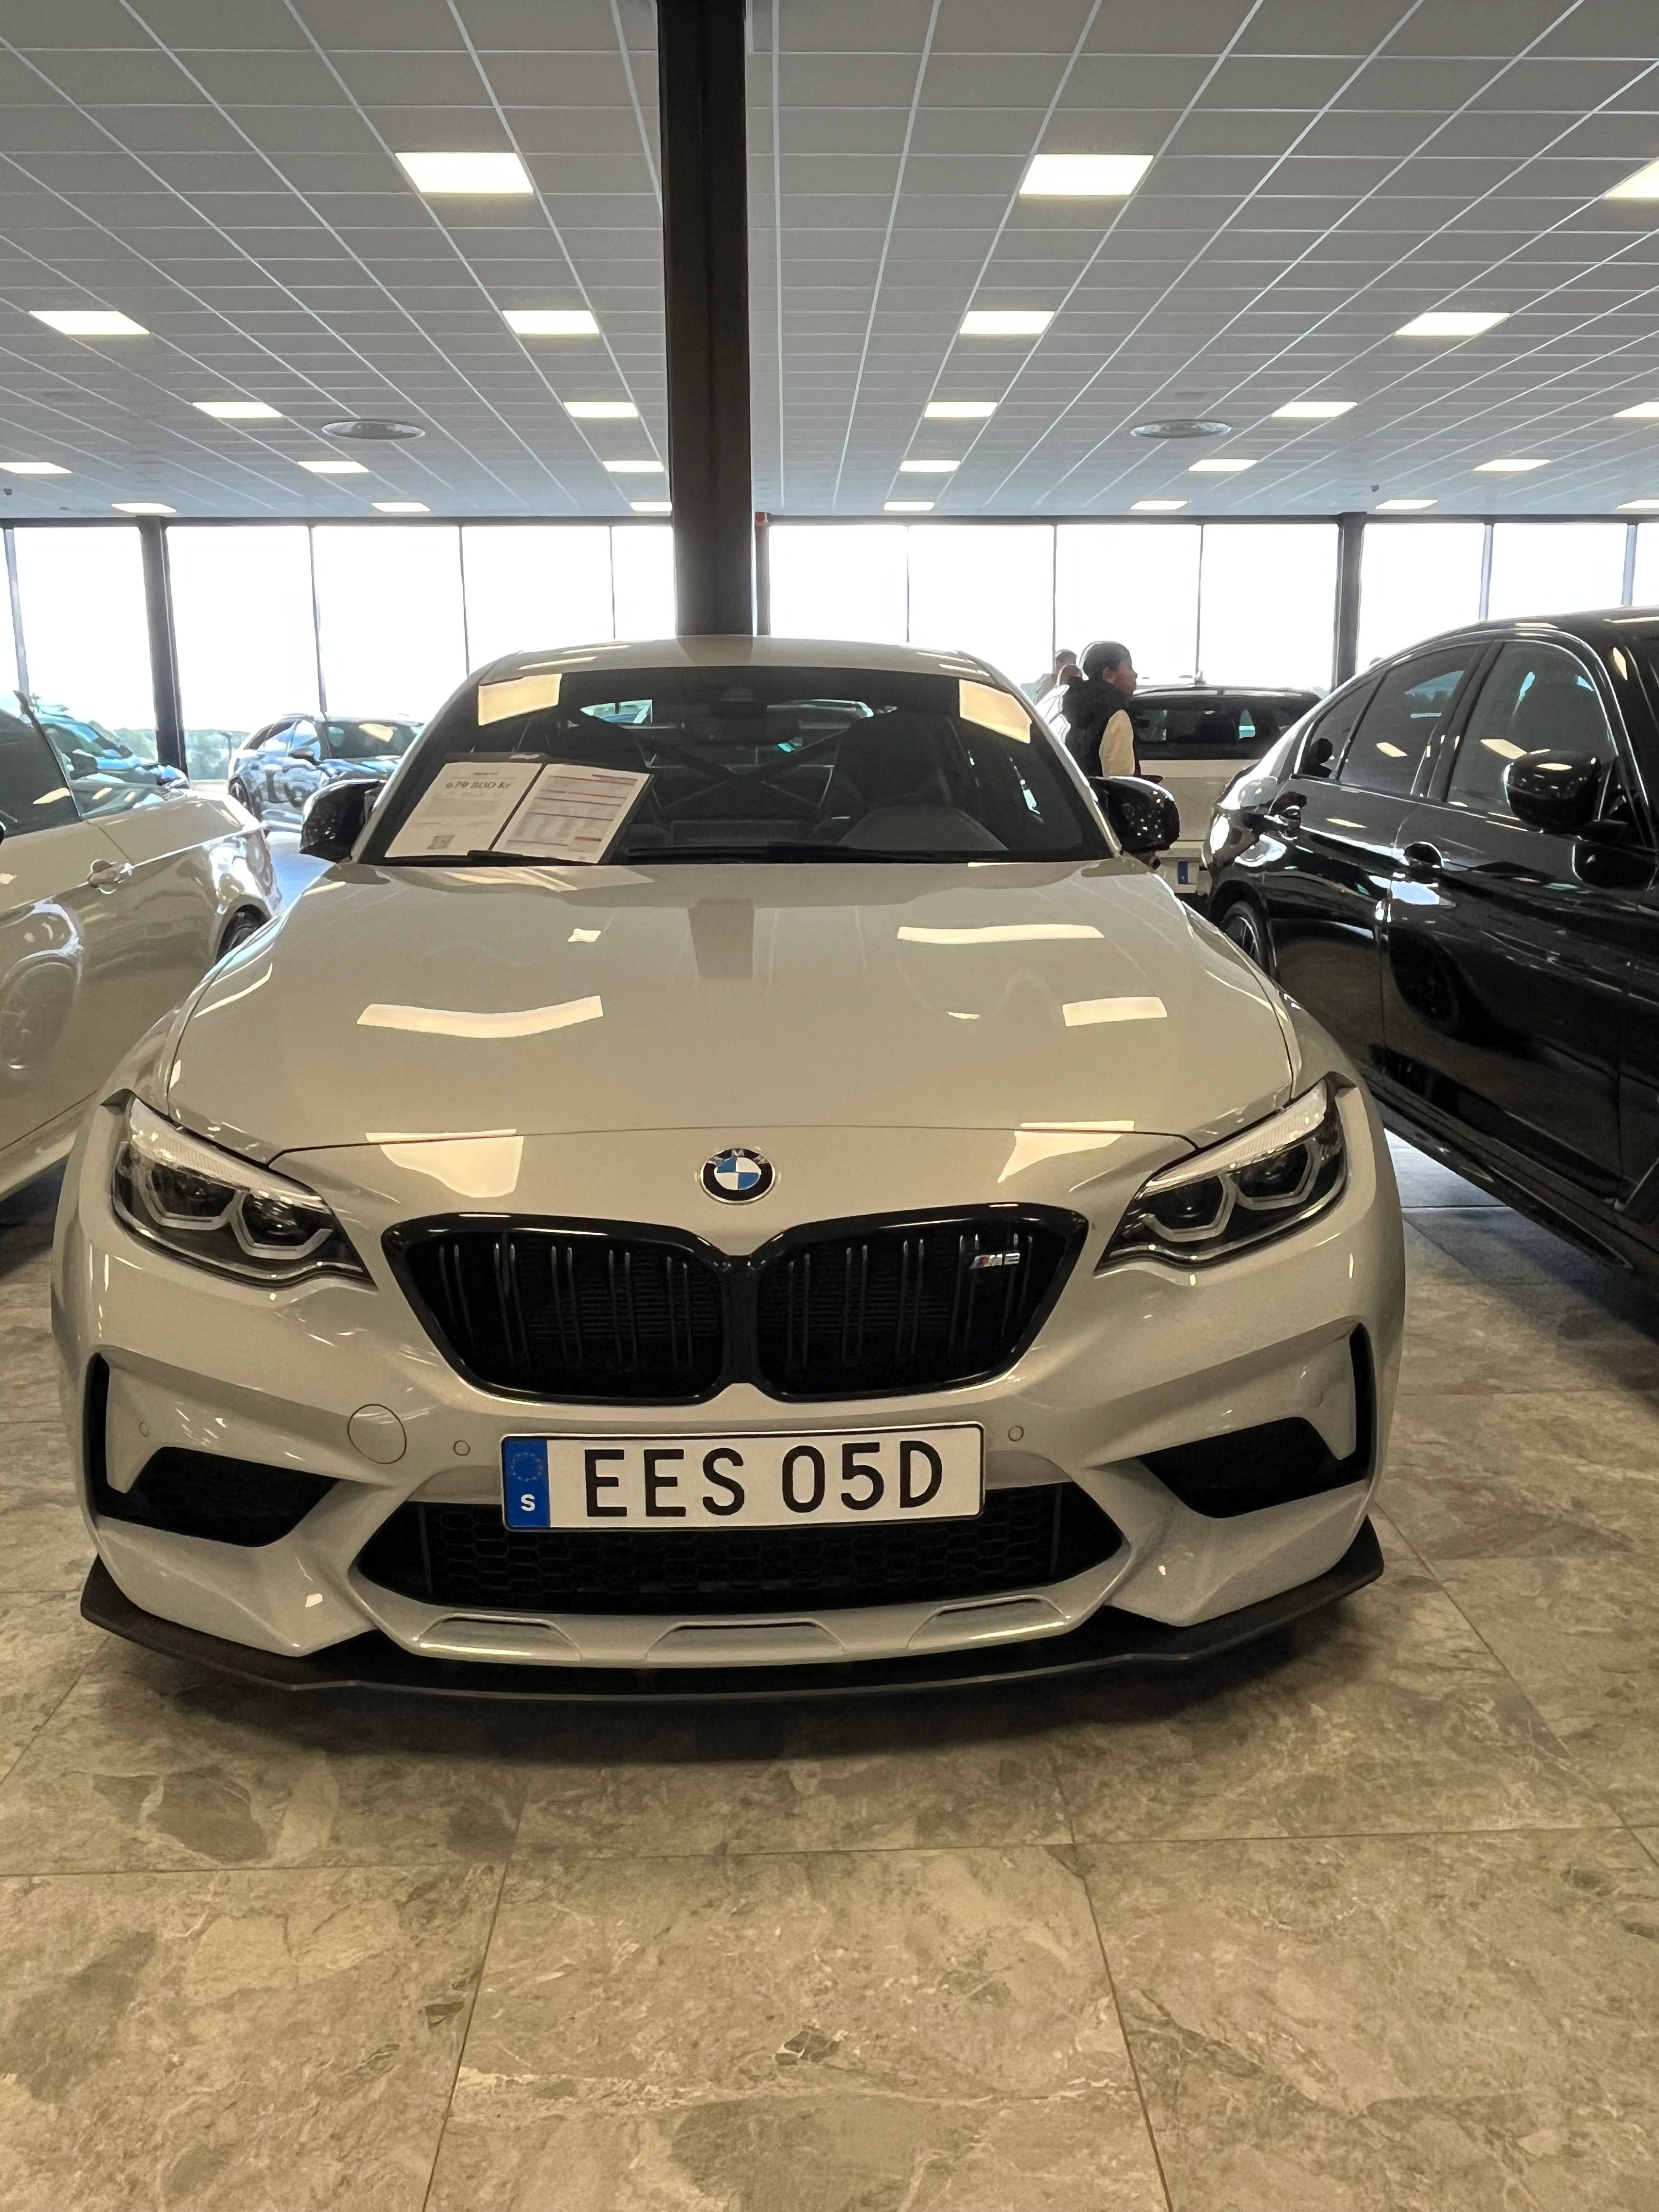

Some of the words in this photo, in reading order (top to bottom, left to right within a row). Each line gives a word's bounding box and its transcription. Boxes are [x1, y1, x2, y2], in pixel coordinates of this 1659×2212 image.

[521, 1493, 535, 1511] S
[584, 1447, 745, 1517] EES
[782, 1440, 943, 1513] 05D
